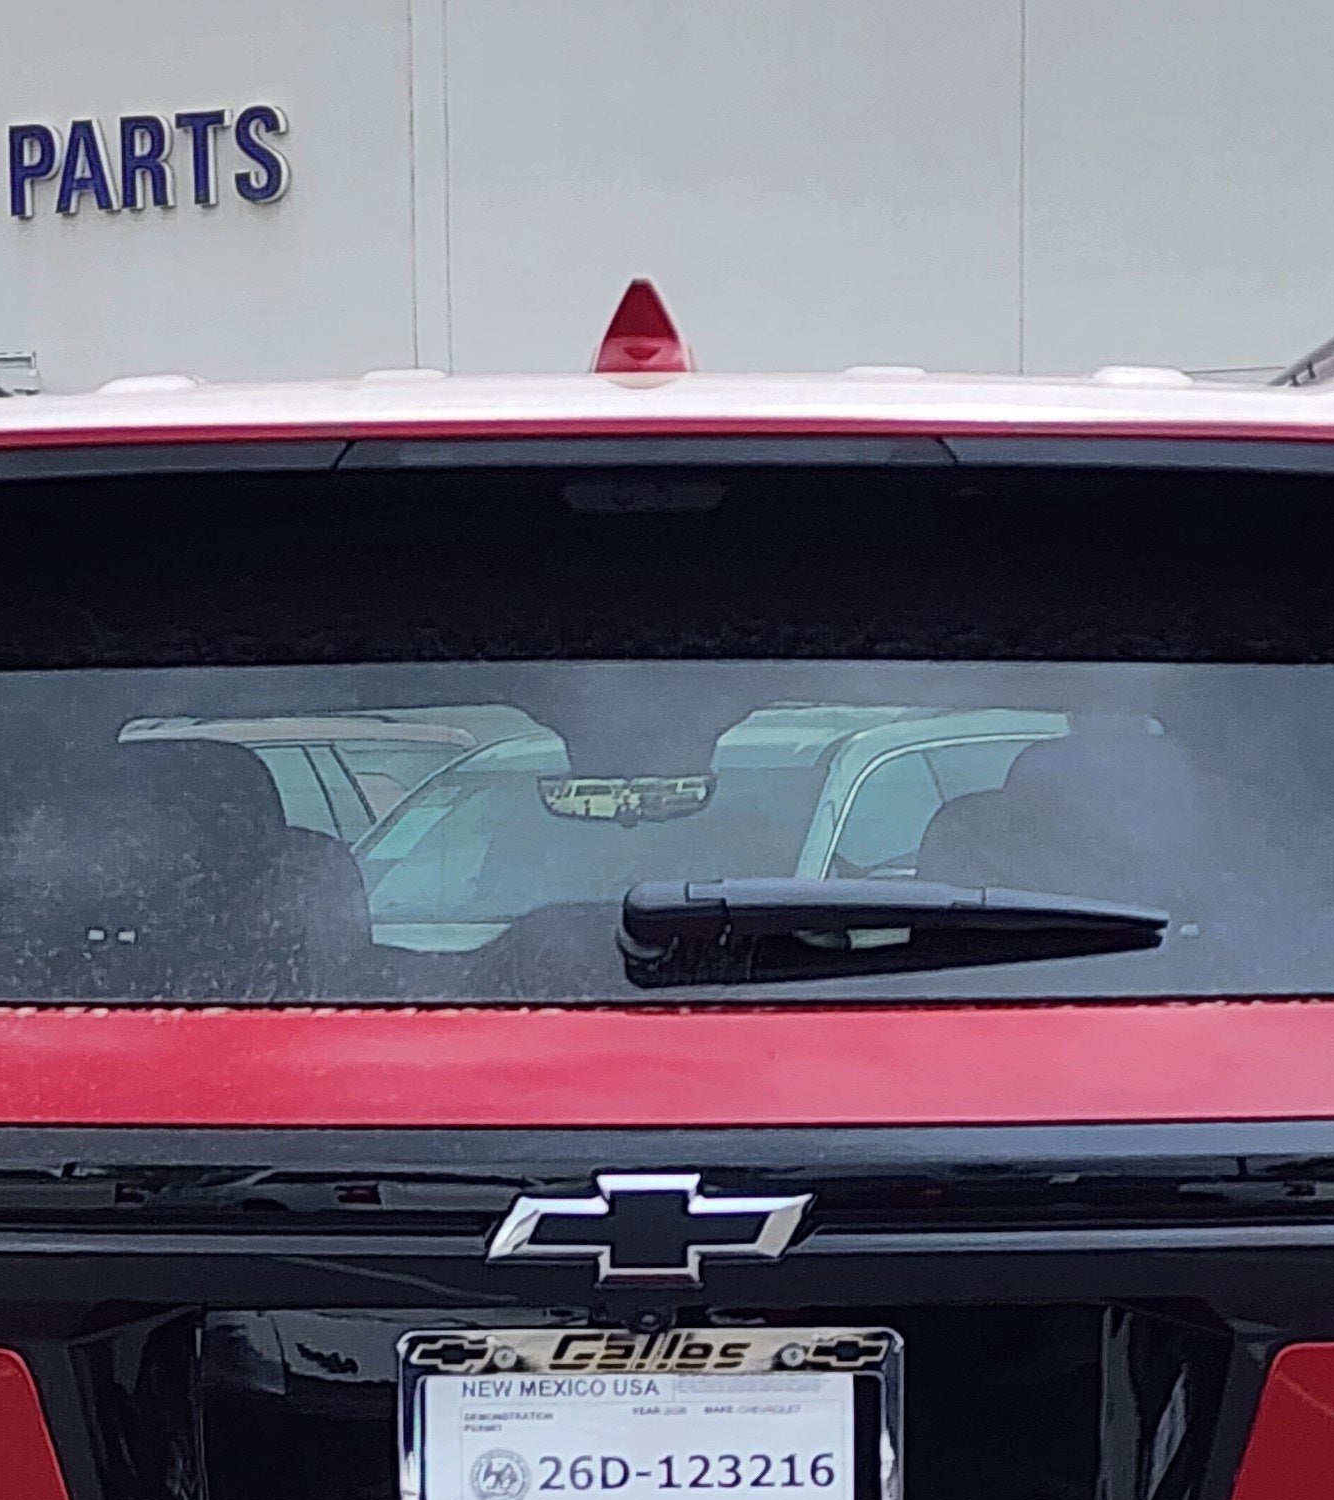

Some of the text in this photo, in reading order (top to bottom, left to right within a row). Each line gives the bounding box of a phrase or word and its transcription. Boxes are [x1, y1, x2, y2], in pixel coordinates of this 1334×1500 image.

[8, 105, 286, 217] PARTS
[548, 1333, 753, 1371] Galles
[462, 1381, 513, 1398] NEW
[519, 1379, 606, 1397] MEXICO
[613, 1378, 660, 1397] USA
[538, 1452, 836, 1492] 26D-123216
